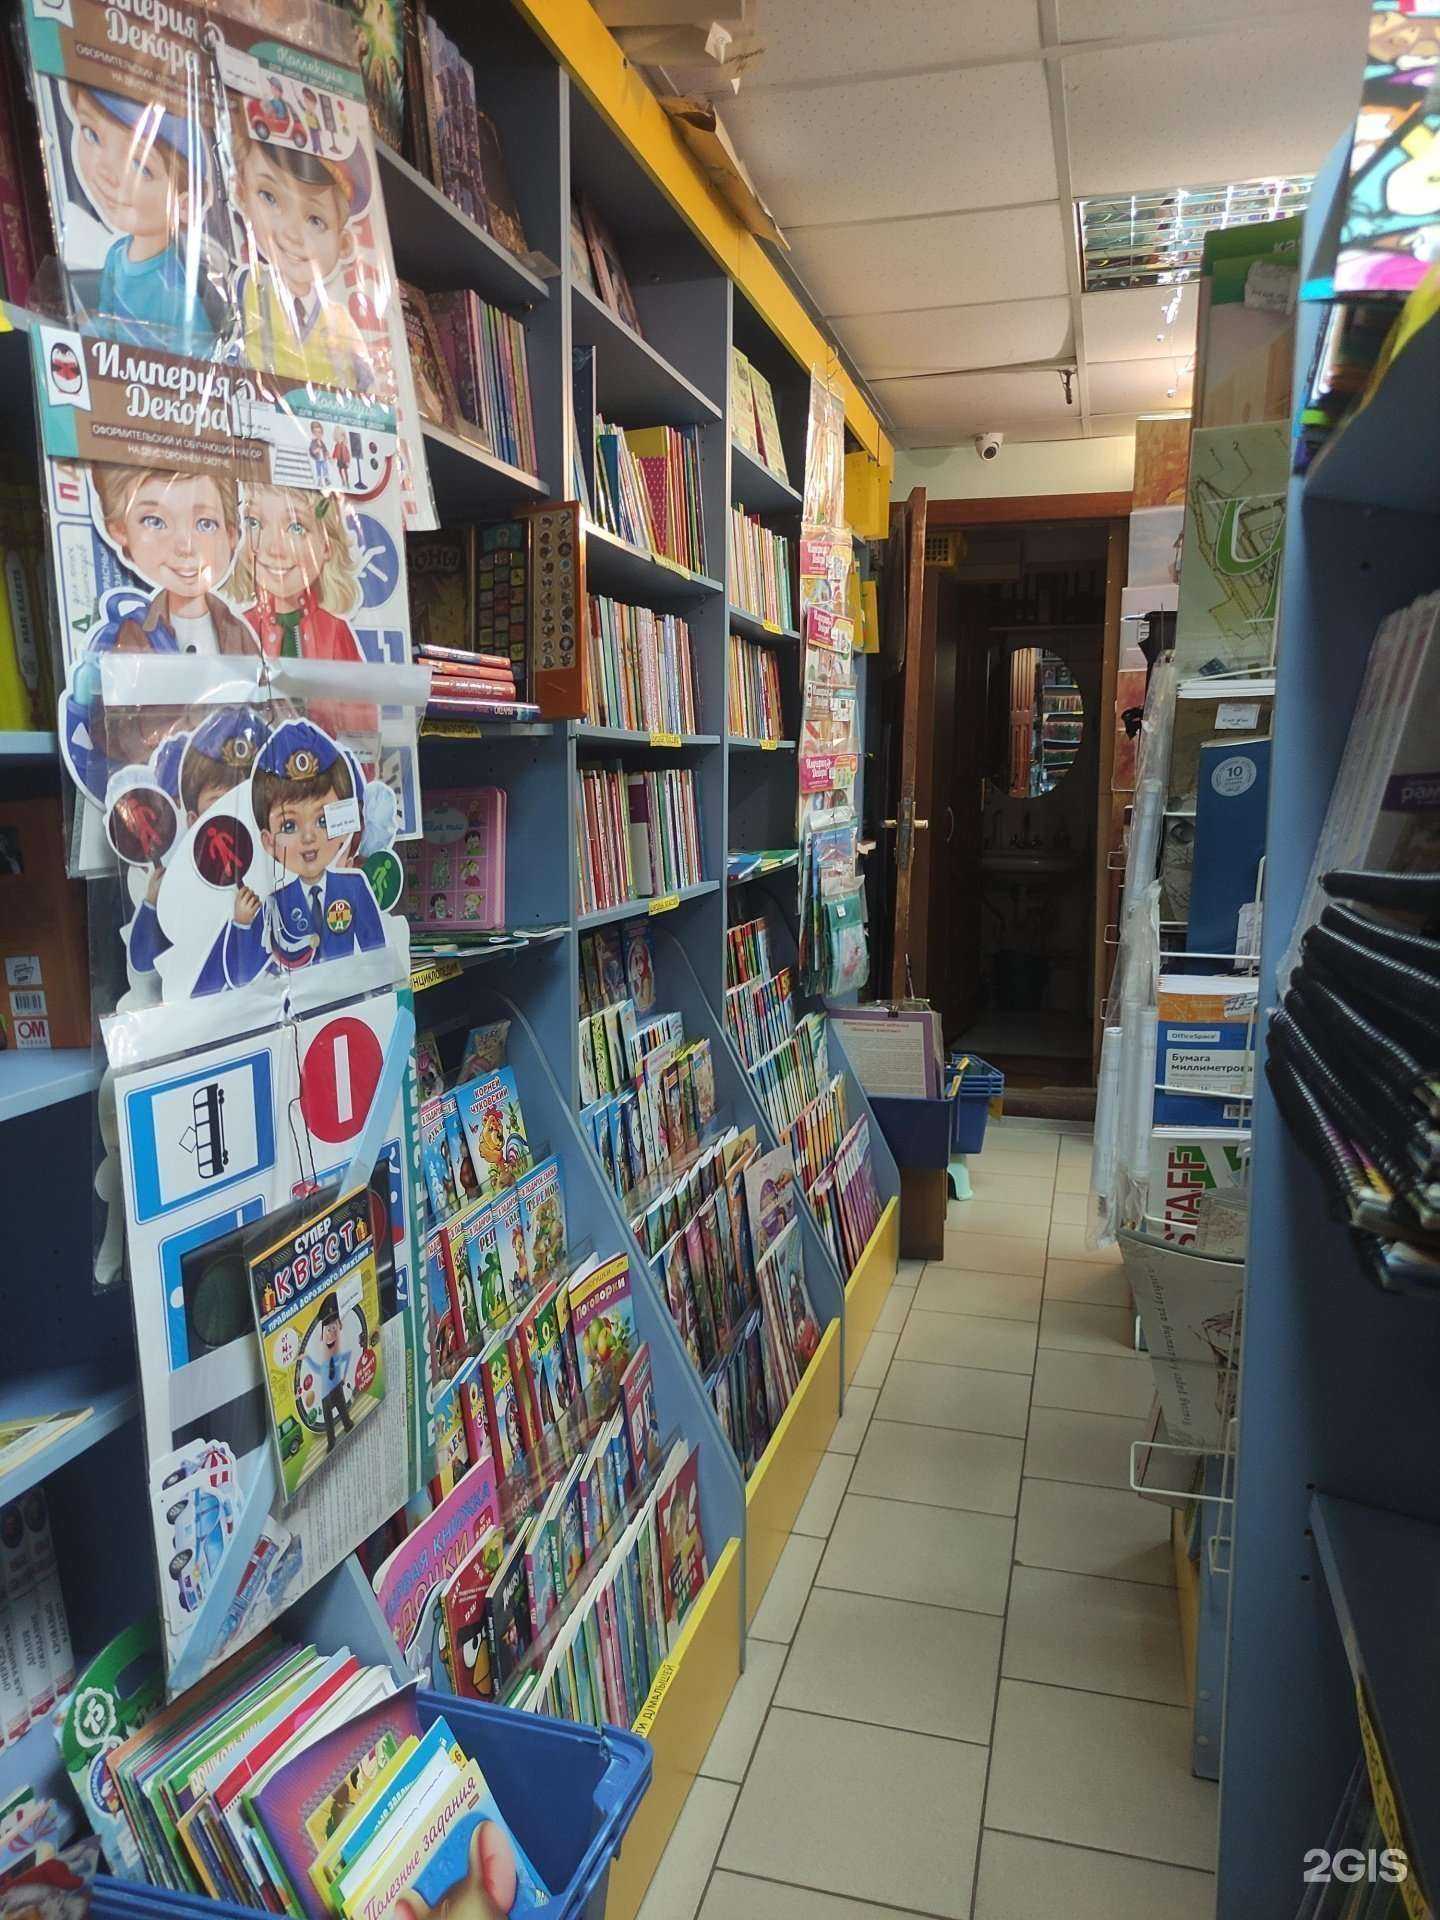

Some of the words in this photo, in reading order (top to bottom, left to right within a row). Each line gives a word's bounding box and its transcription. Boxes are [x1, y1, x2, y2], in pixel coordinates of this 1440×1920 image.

[102, 0, 199, 41] перия
[105, 7, 200, 75] Декора
[92, 341, 230, 404] Империя
[125, 384, 232, 437] Декора
[1226, 766, 1243, 777] 10
[1171, 1053, 1211, 1063] Бумага
[470, 1085, 509, 1114] ЧУКОВСКИЙ
[473, 1076, 500, 1098] КОРНЕЙ
[294, 1216, 332, 1254] СУПЕР
[274, 1219, 355, 1306] КВЕСТ
[299, 1271, 339, 1309] ДОРОЖНОГО
[363, 1850, 421, 1920] Полезные
[422, 1776, 477, 1852] задания
